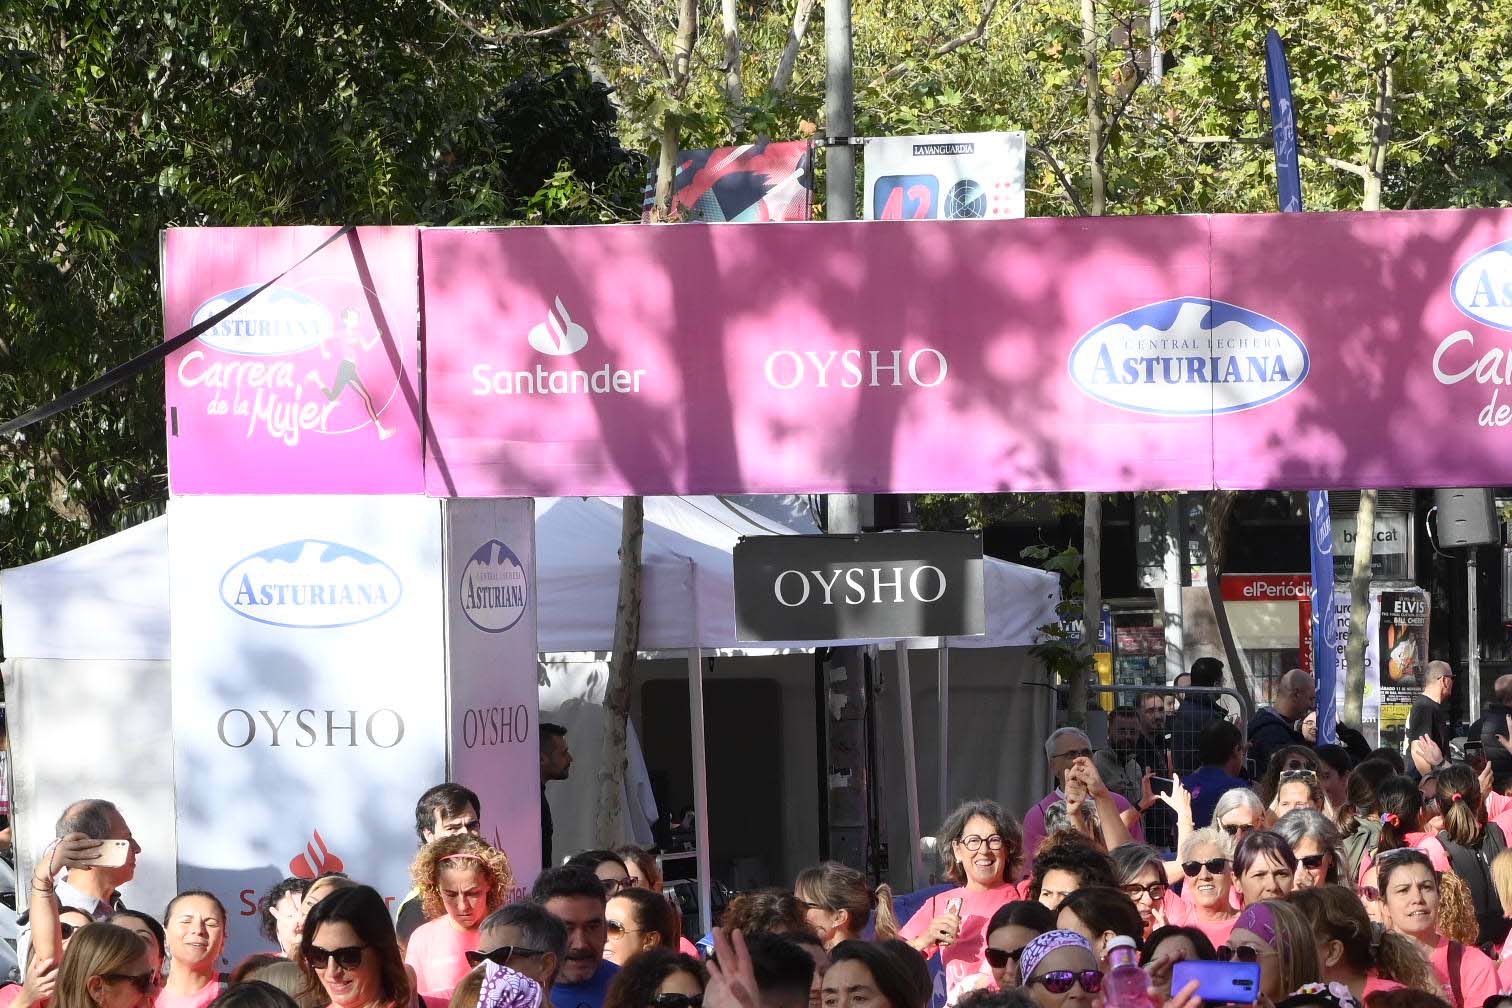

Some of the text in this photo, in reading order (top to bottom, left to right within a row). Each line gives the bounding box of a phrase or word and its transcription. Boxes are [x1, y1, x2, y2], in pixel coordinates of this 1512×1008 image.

[1124, 338, 1201, 350] CENTRAL
[178, 350, 296, 388] Carrera
[471, 362, 647, 396] Santander
[764, 347, 949, 390] OYSHO
[1089, 342, 1291, 386] ASTURIANA
[207, 384, 341, 447] de la Mujer
[1478, 387, 1512, 427] de
[234, 573, 389, 606] ASTURIANA
[466, 574, 524, 610] ASTURIANA
[773, 565, 948, 607] OYSHO
[1243, 581, 1313, 597] elPeriódi
[1394, 601, 1425, 613] ELVIS
[216, 708, 406, 749] OYSHO
[463, 704, 529, 752] OYSHO
